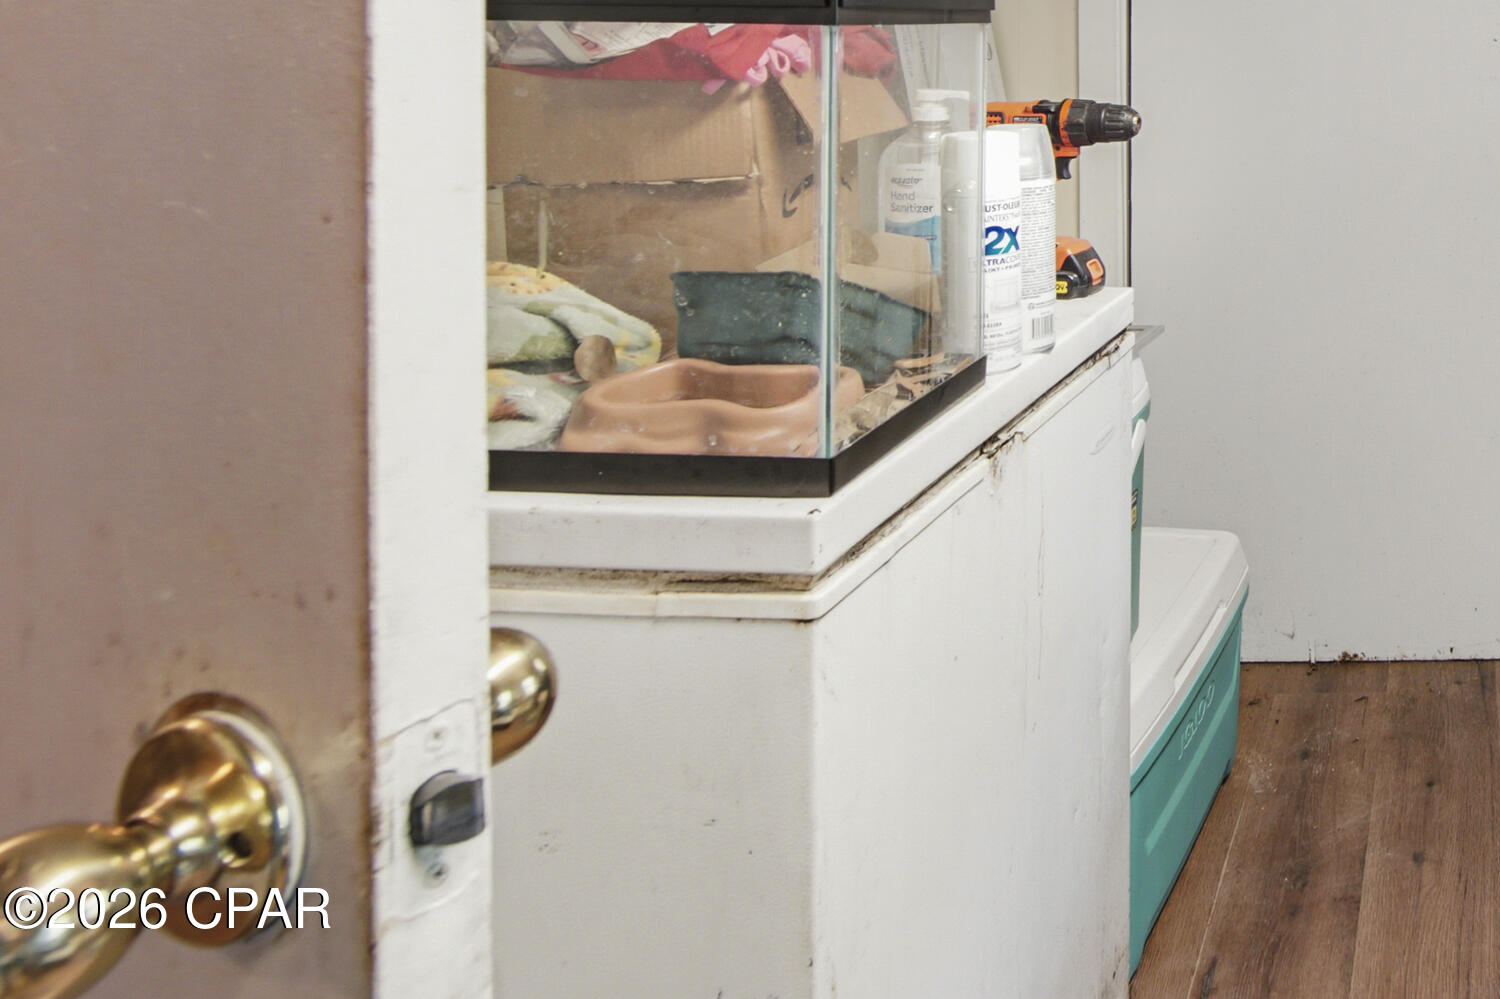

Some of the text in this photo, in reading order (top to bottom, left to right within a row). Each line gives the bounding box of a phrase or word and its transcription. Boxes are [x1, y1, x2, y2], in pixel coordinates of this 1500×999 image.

[890, 191, 916, 201] Hand
[890, 202, 935, 214] Sanitizer
[984, 225, 1020, 256] 2X
